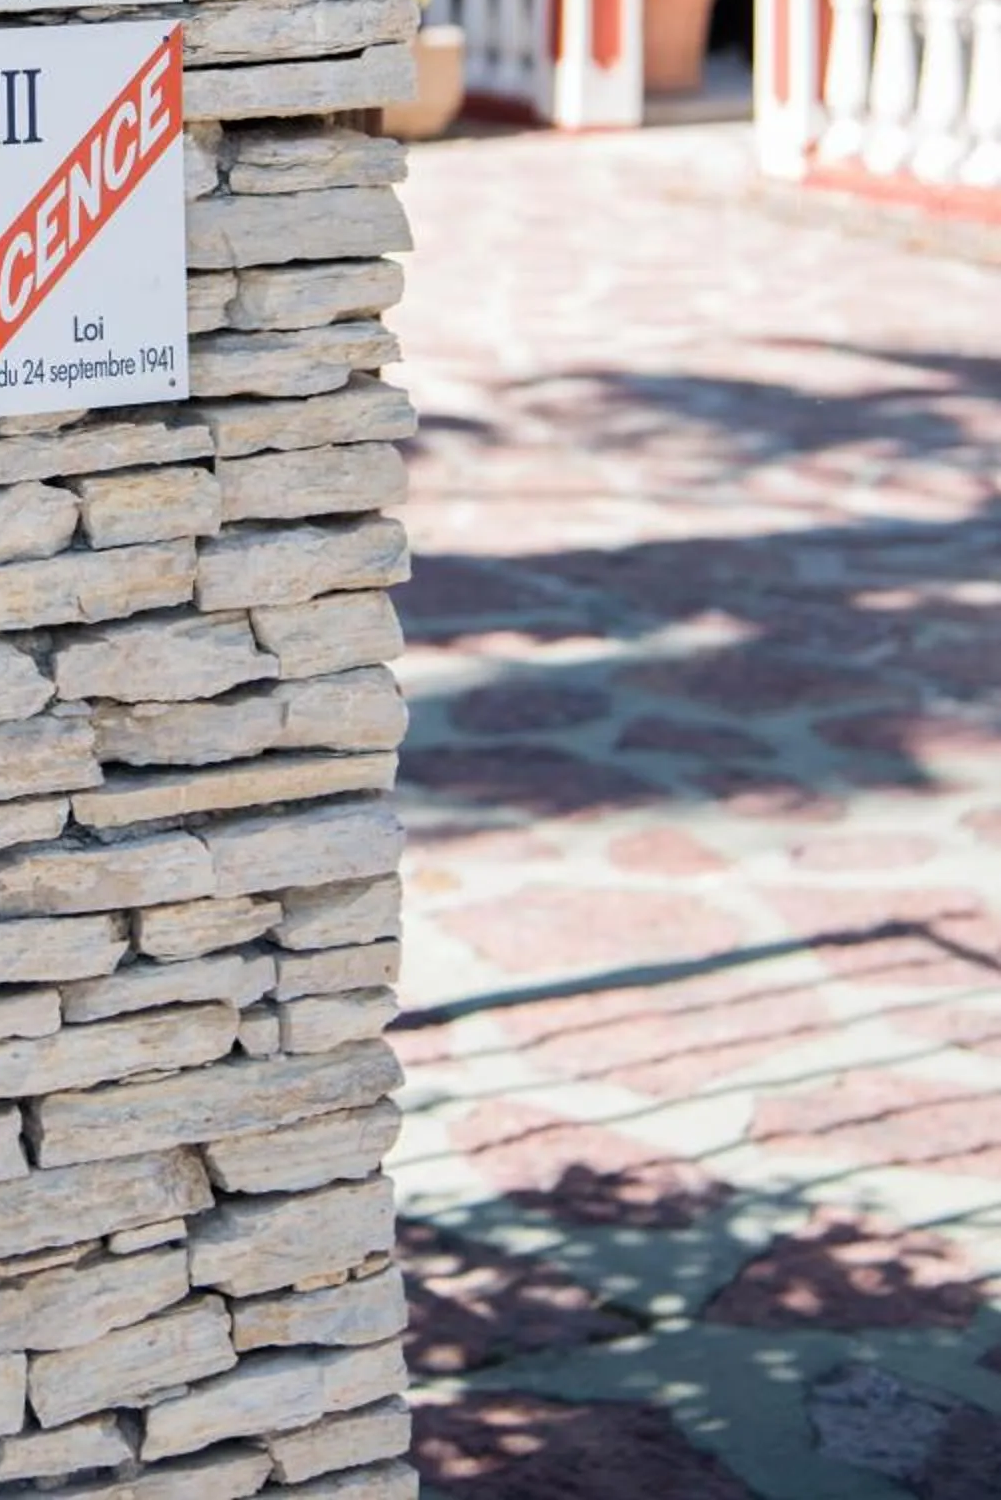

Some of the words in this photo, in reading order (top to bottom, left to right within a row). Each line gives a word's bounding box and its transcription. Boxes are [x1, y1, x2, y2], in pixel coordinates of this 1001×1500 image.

[73, 316, 104, 342] Loi
[23, 358, 44, 385] 24
[50, 349, 136, 388] septembre
[140, 346, 174, 373] 1941
